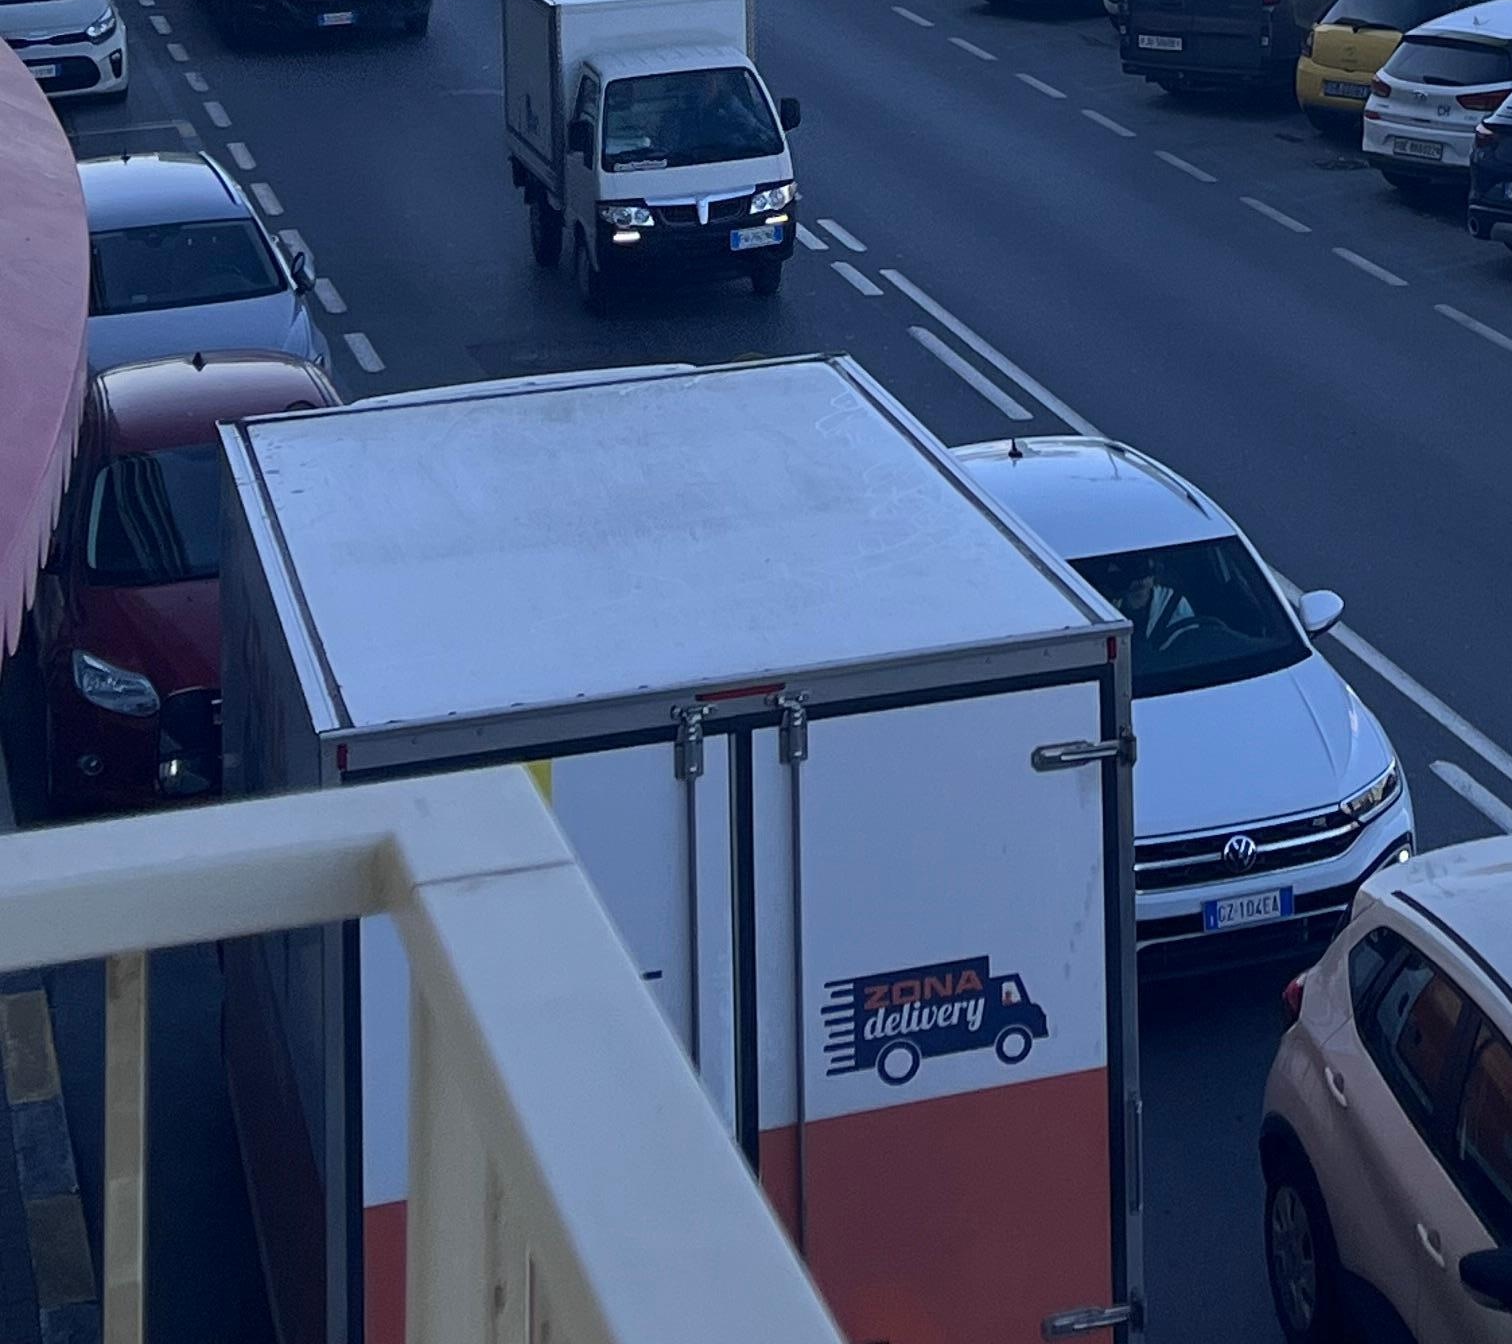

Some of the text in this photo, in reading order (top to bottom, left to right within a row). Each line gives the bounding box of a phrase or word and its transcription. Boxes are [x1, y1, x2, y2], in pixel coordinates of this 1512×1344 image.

[1239, 894, 1280, 919] 104EA
[864, 969, 984, 1010] ZONA
[864, 997, 985, 1041] delivery
